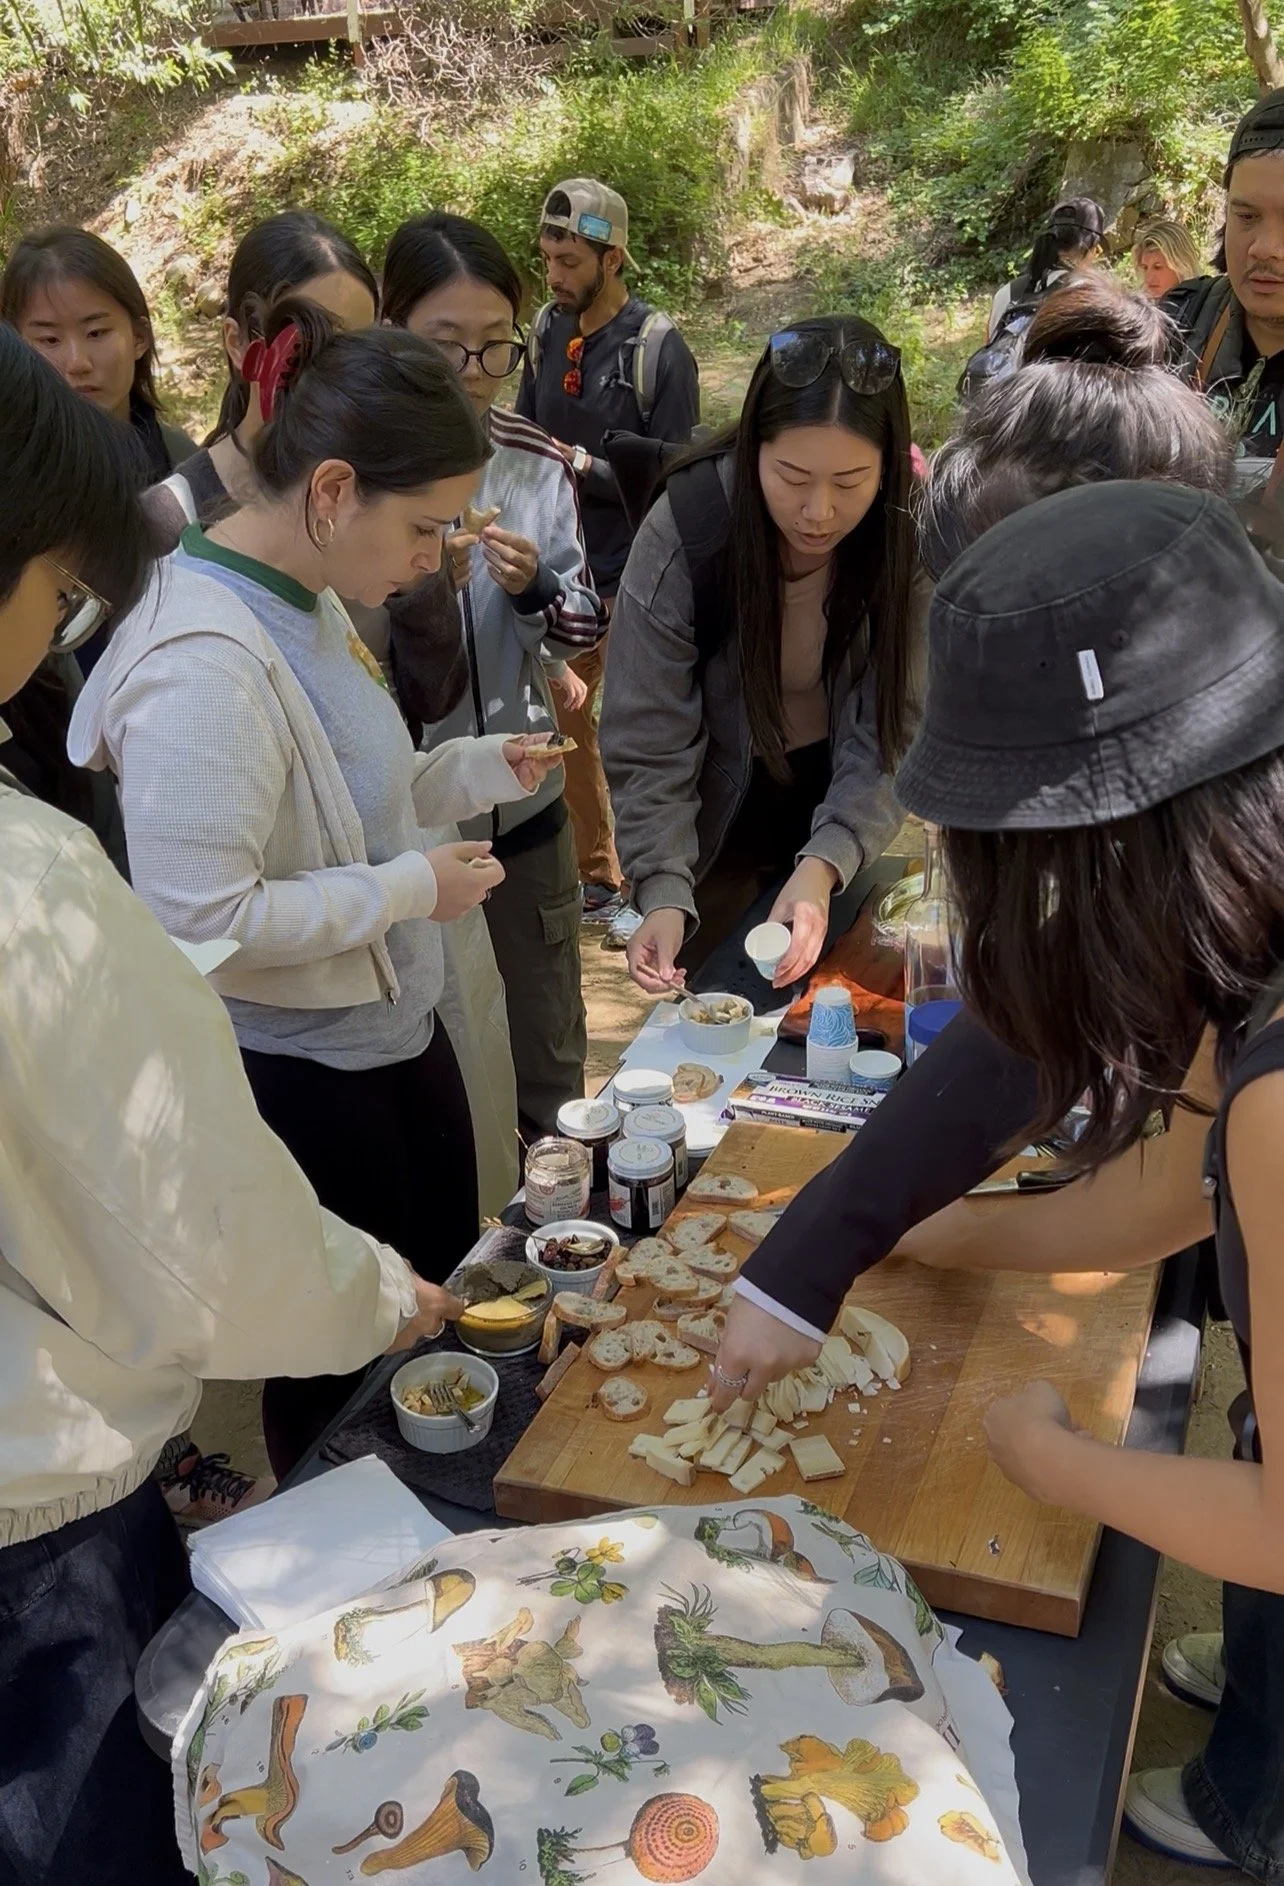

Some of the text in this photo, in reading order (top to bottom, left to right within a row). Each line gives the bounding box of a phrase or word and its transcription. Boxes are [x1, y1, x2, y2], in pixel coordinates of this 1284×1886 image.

[769, 1085, 822, 1098] BROWN
[826, 1093, 856, 1104] RICE
[829, 1103, 871, 1113] SESAME
[519, 1859, 527, 1871] 10
